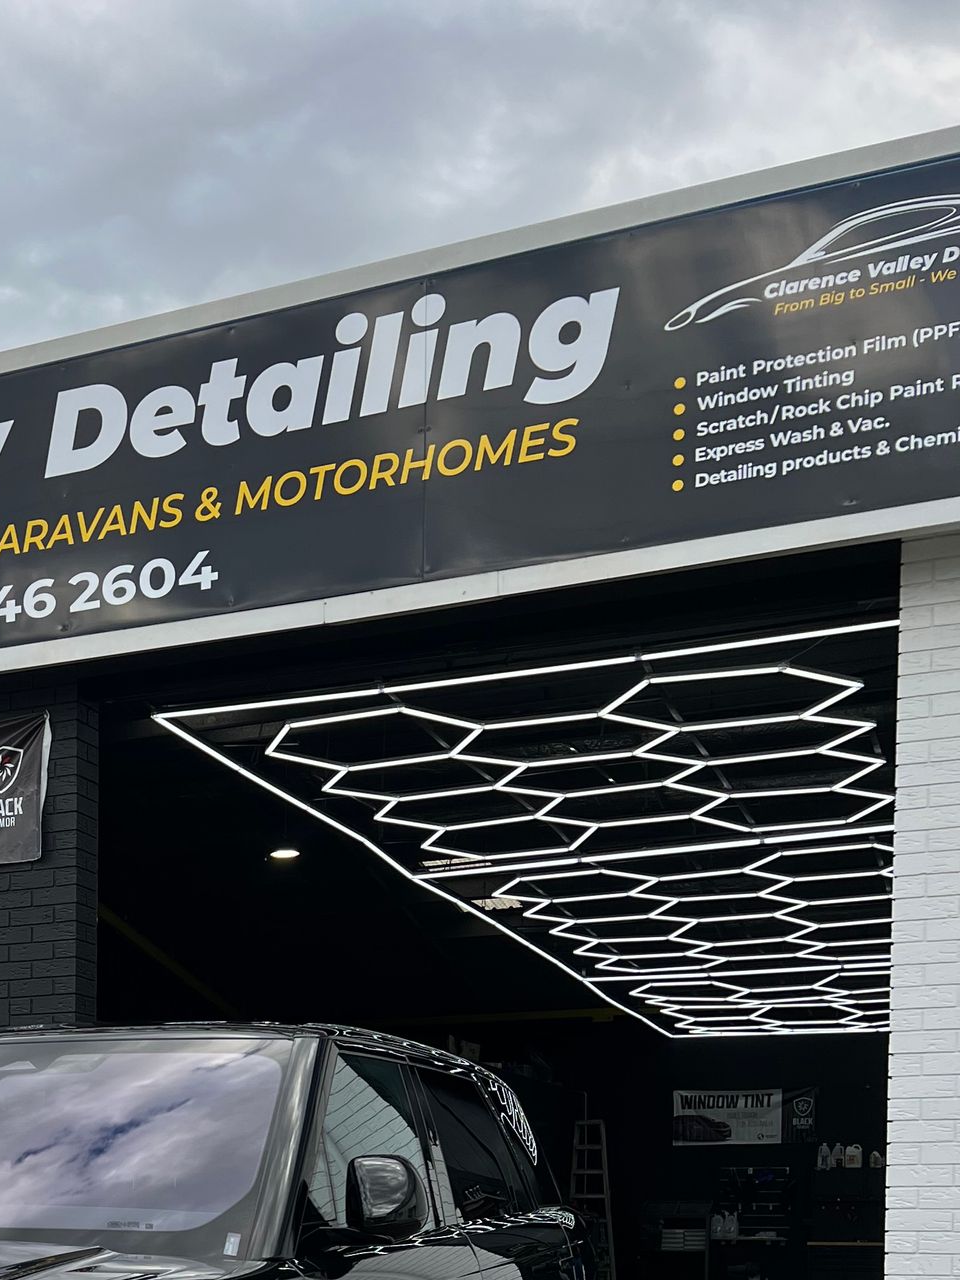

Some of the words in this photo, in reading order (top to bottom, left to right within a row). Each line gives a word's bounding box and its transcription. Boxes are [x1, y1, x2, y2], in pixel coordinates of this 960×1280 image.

[763, 268, 861, 299] Clarence
[868, 251, 939, 279] Valley
[773, 299, 815, 316] From
[819, 290, 845, 308] Big
[849, 286, 865, 300] to
[869, 275, 916, 296] Small
[930, 268, 957, 283] We
[44, 287, 620, 478] Detailing
[695, 362, 747, 387] Paint
[752, 342, 858, 376] Protection
[863, 331, 908, 355] Film
[695, 400, 832, 438] Scratch/Rock
[837, 389, 884, 411] Chip
[889, 378, 945, 401] Paint
[697, 385, 778, 412] Window
[783, 368, 856, 395] Tinting
[694, 438, 765, 464] Express
[770, 426, 826, 449] Wash
[830, 421, 844, 437] &
[847, 415, 891, 434] Vac.
[694, 462, 777, 489] Detailing
[782, 443, 872, 474] products
[876, 439, 891, 456] &
[193, 486, 222, 523] &
[234, 418, 580, 516] MOTORHOMES
[68, 550, 220, 613] 2604
[680, 1093, 740, 1111] WINDOW
[742, 1092, 775, 1109] TINT
